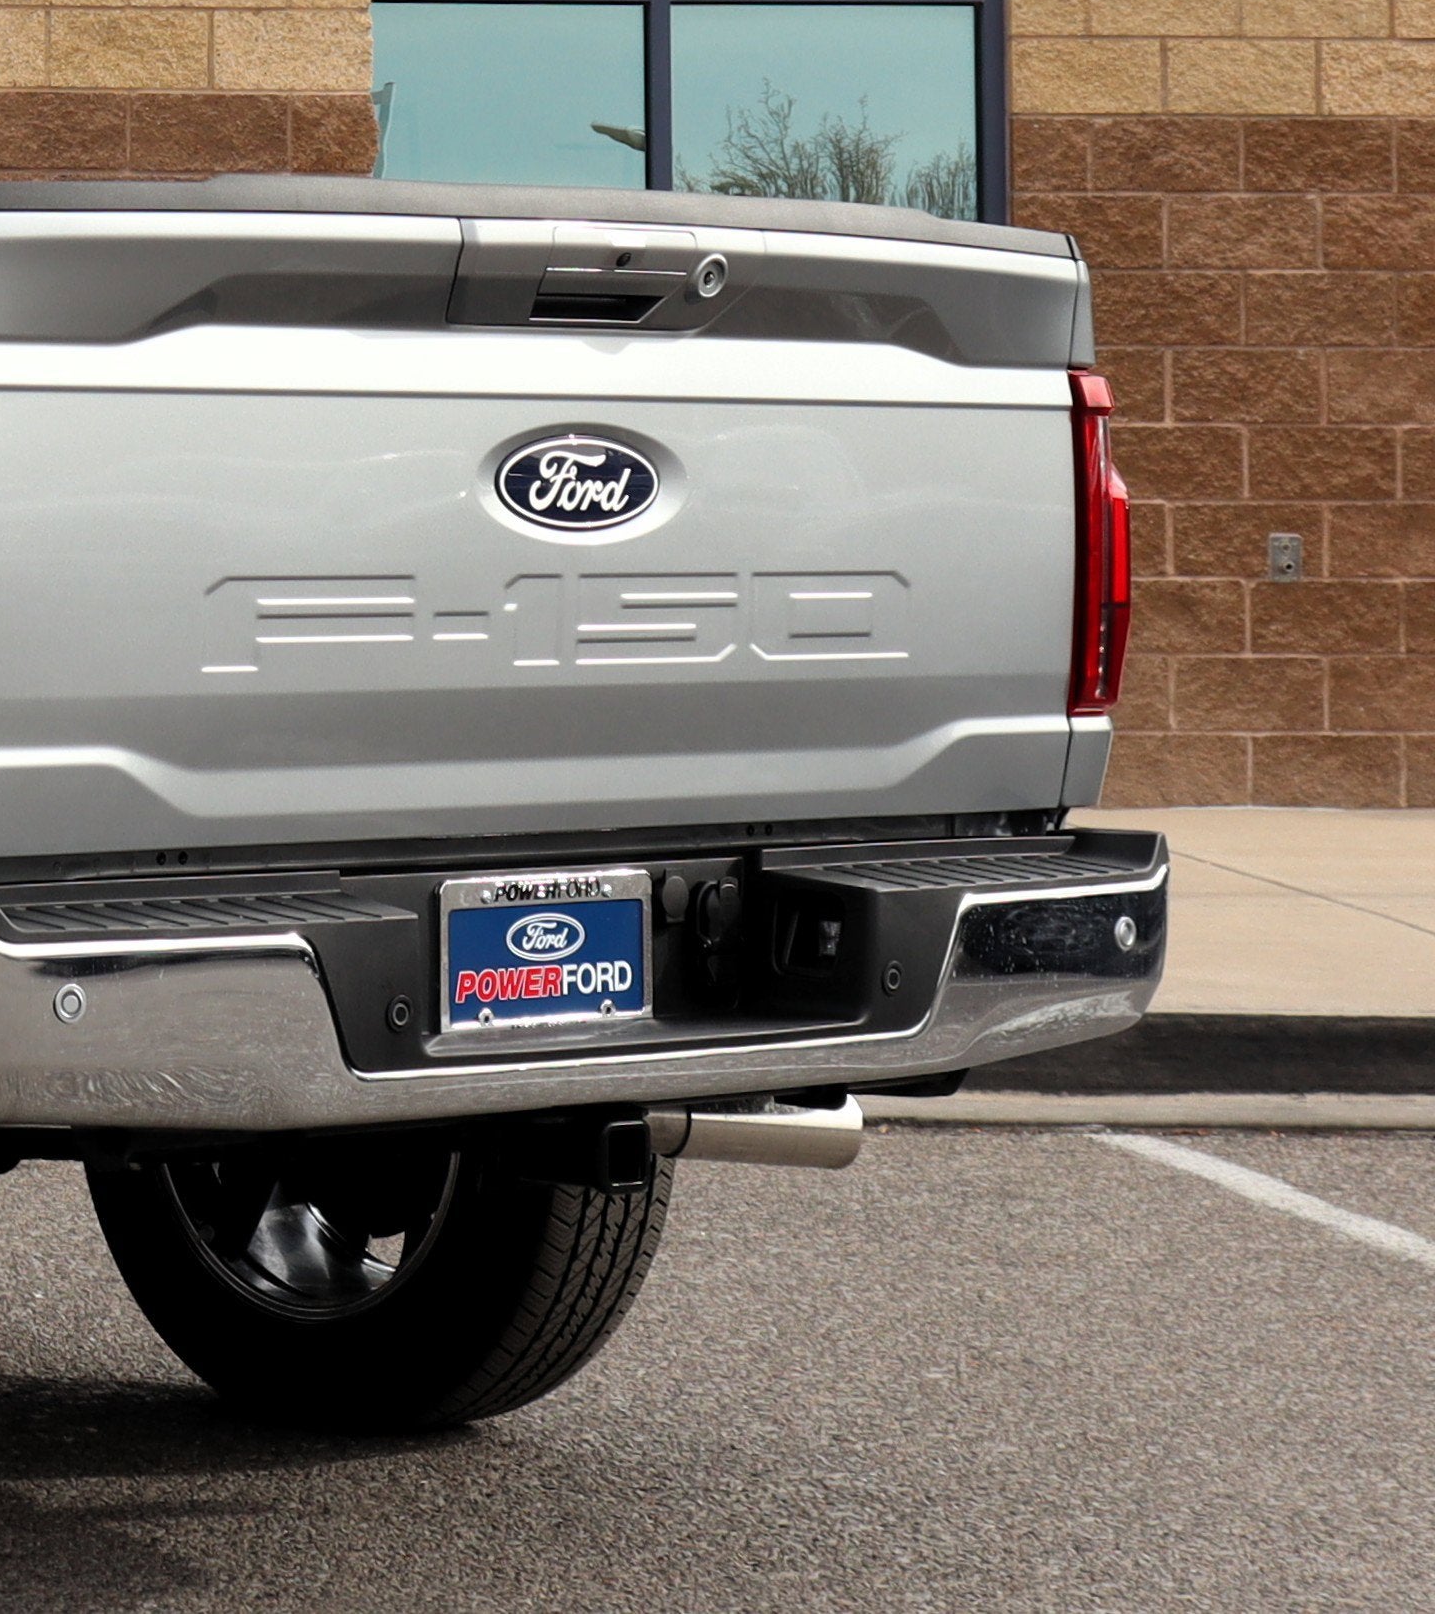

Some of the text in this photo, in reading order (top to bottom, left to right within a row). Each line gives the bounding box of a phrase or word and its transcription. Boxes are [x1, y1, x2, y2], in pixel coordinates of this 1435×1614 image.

[529, 449, 631, 513] Ford
[202, 571, 910, 674] F-150
[522, 922, 569, 950] Ford
[455, 960, 632, 1004] POWERFORD
